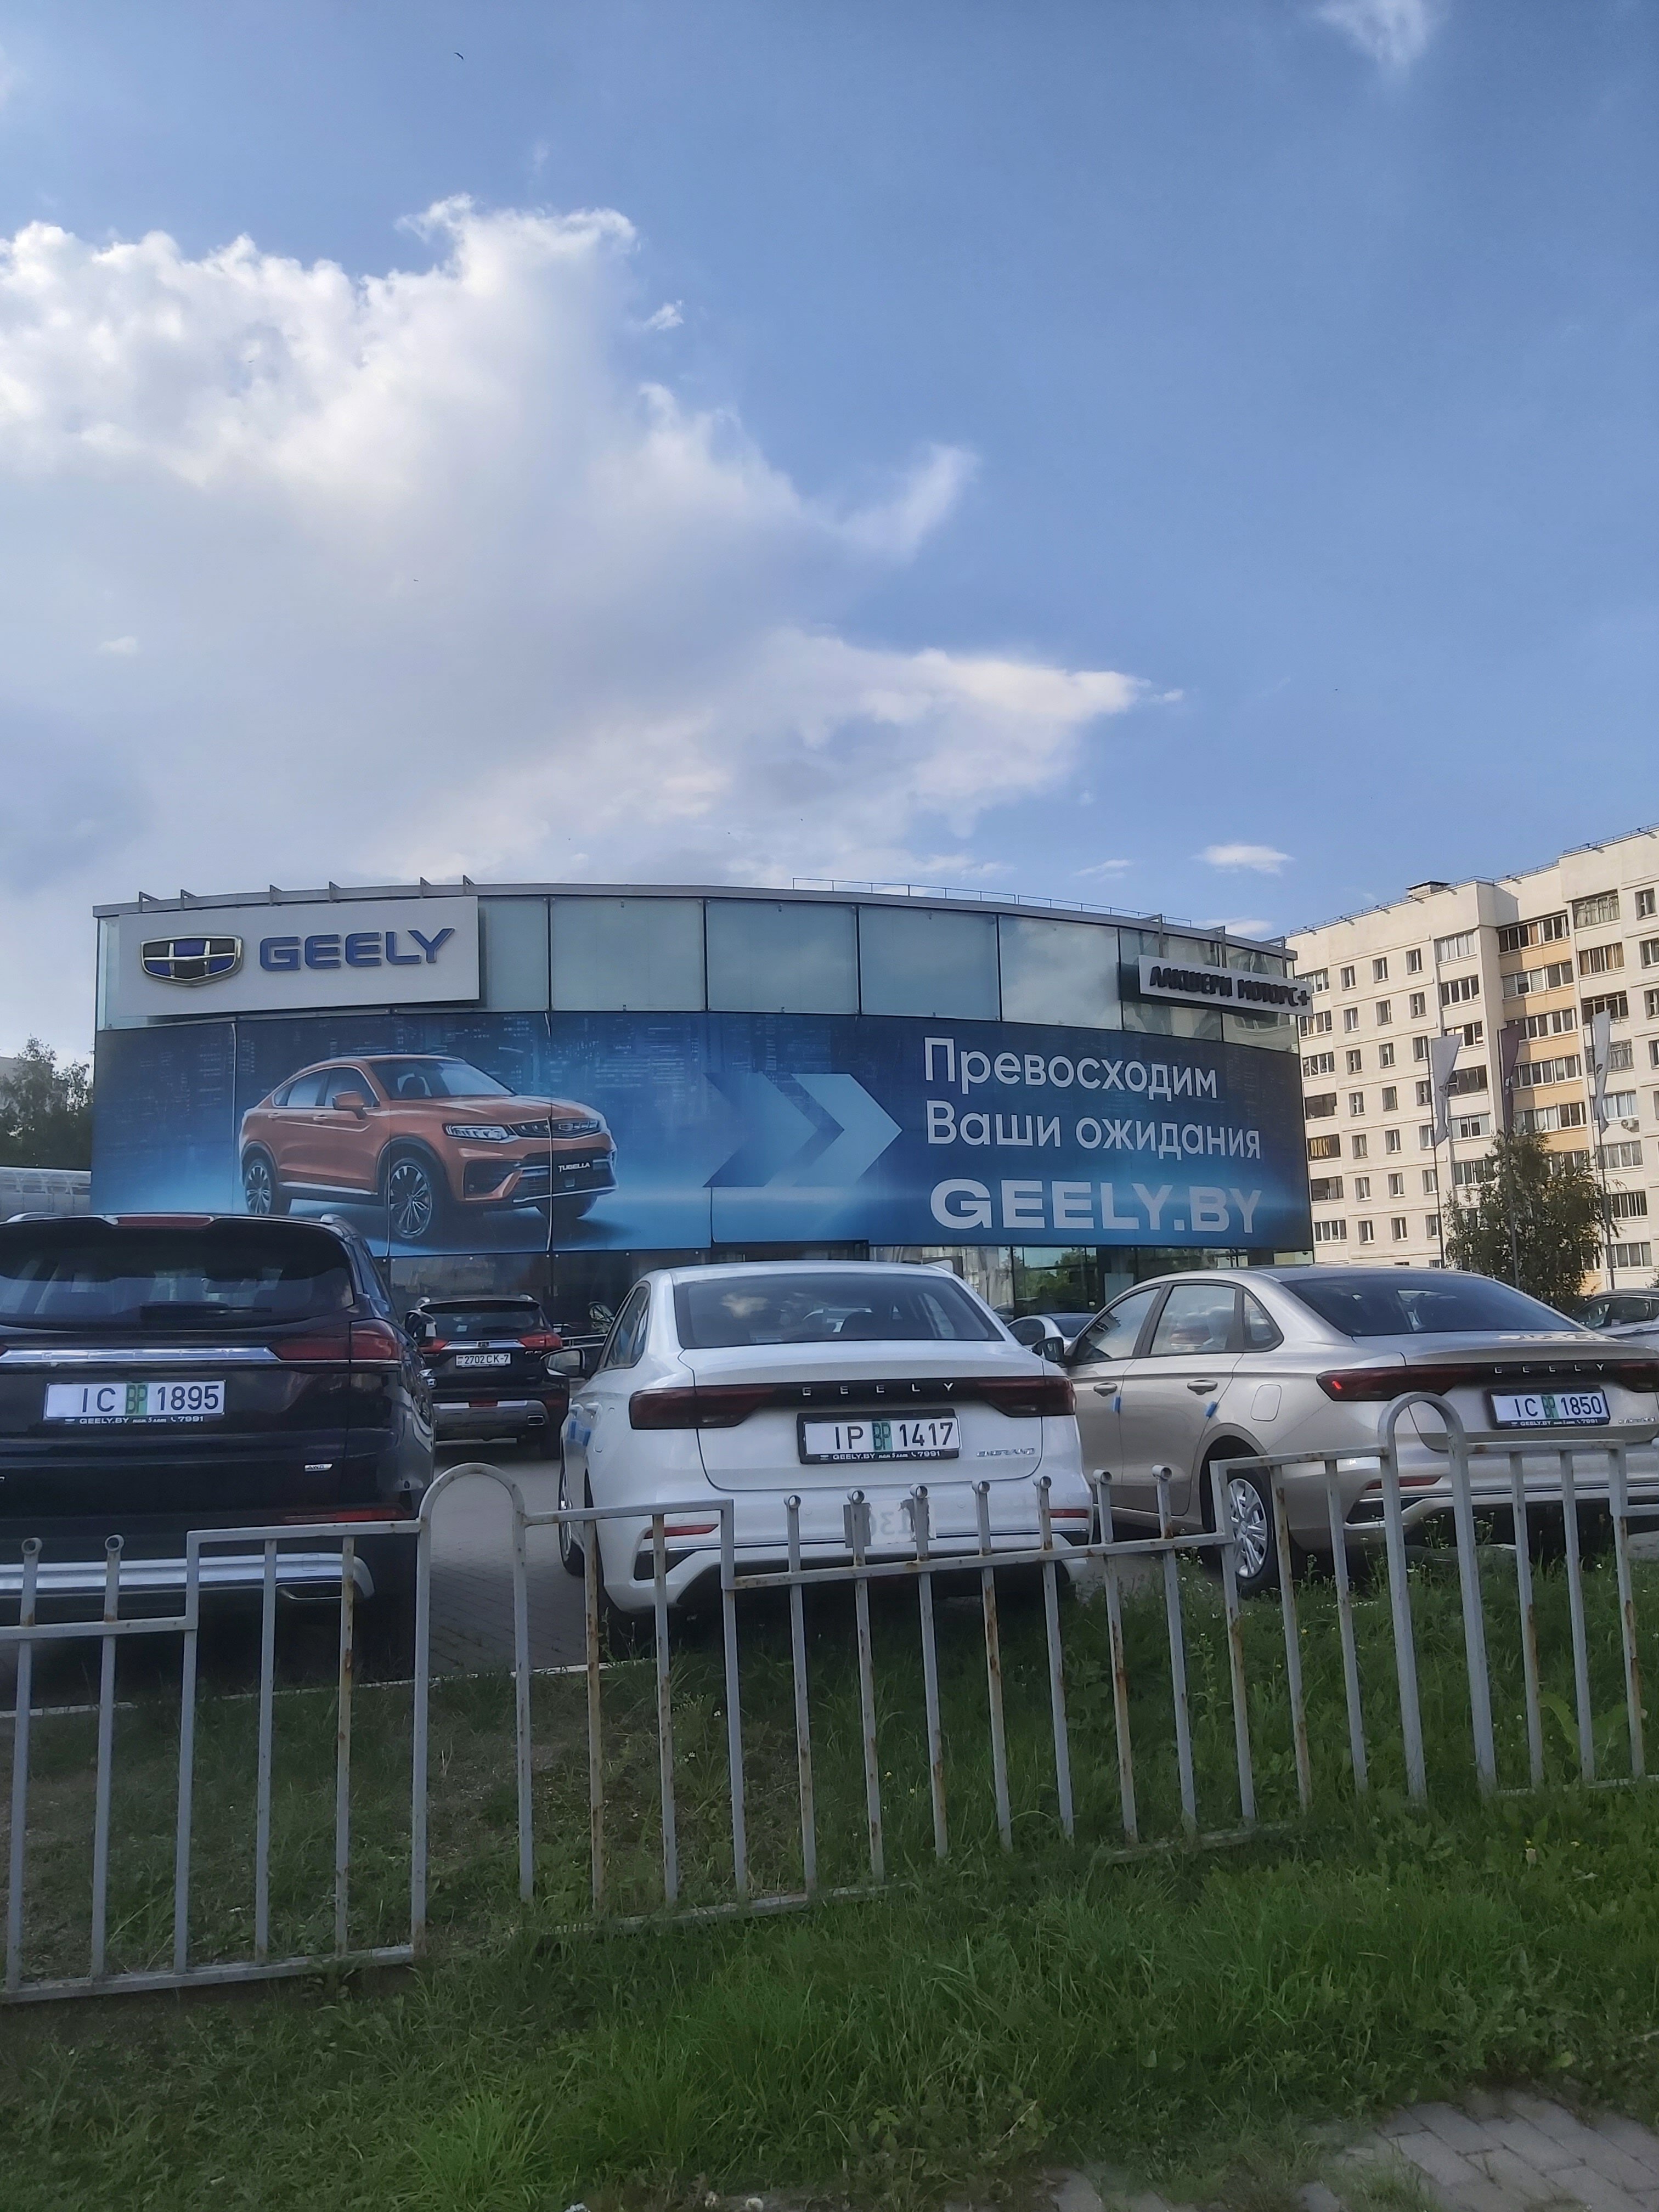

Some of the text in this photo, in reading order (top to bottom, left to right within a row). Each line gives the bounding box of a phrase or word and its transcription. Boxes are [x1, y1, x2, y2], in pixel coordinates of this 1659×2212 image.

[260, 928, 455, 971] GEELY
[924, 1037, 1217, 1101] Превосходим
[927, 1100, 1260, 1160] Ваши ожидания
[930, 1179, 1261, 1233] GEELY.BY
[82, 1385, 219, 1414] IC BP 1895
[802, 1383, 954, 1396] GEELY
[1514, 1397, 1538, 1417] IC
[1560, 1396, 1602, 1416] 1850
[834, 1422, 953, 1450] IP BP 1417
